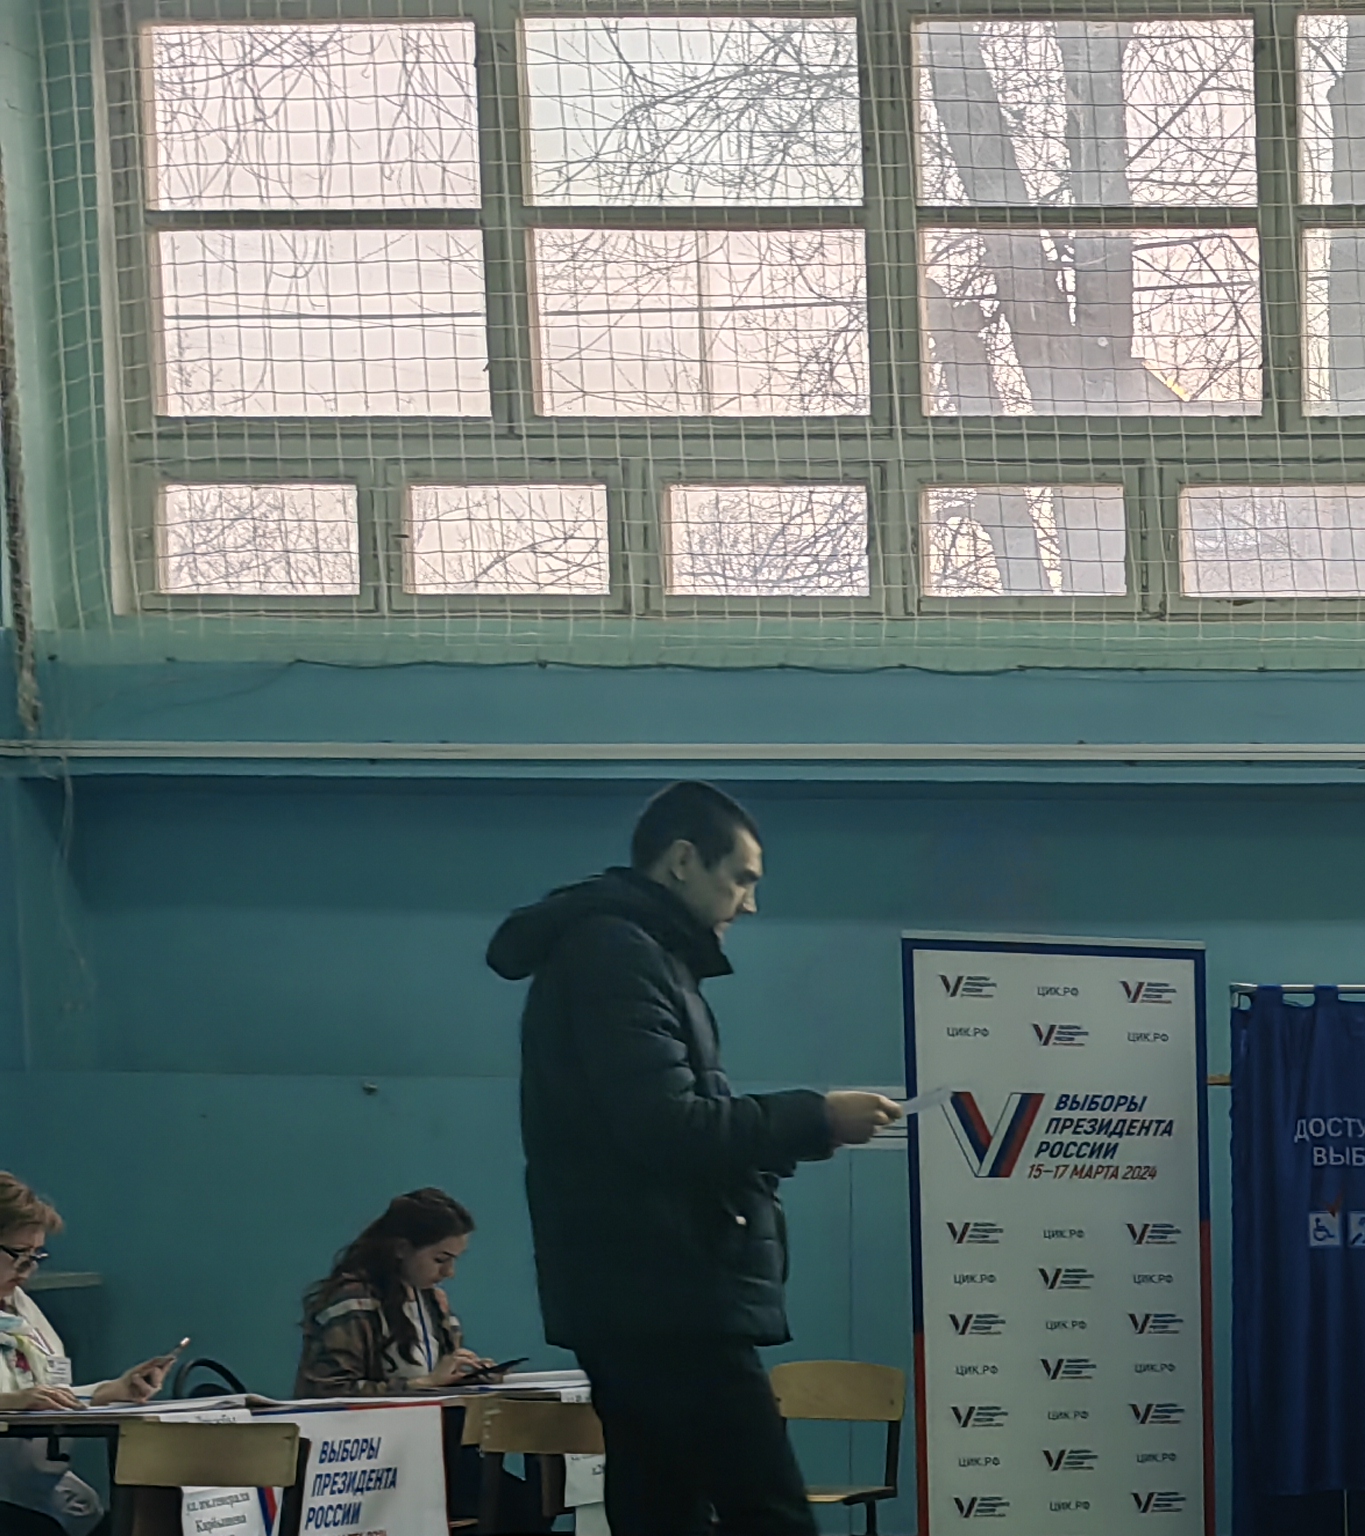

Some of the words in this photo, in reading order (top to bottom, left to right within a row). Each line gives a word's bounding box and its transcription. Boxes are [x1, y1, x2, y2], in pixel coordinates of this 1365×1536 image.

[1055, 1094, 1147, 1112] ВЫБОРЫ
[1045, 1118, 1174, 1138] ПРЕЗИДЕНТА
[1035, 1141, 1120, 1159] РОССИИ
[1070, 1164, 1119, 1179] МАРТА
[1121, 1165, 1157, 1180] 2024
[319, 1437, 381, 1464] ВЫБОРЫ
[311, 1467, 397, 1497] ПРЕЗИДЕНТА
[305, 1501, 361, 1530] РОССИИ
